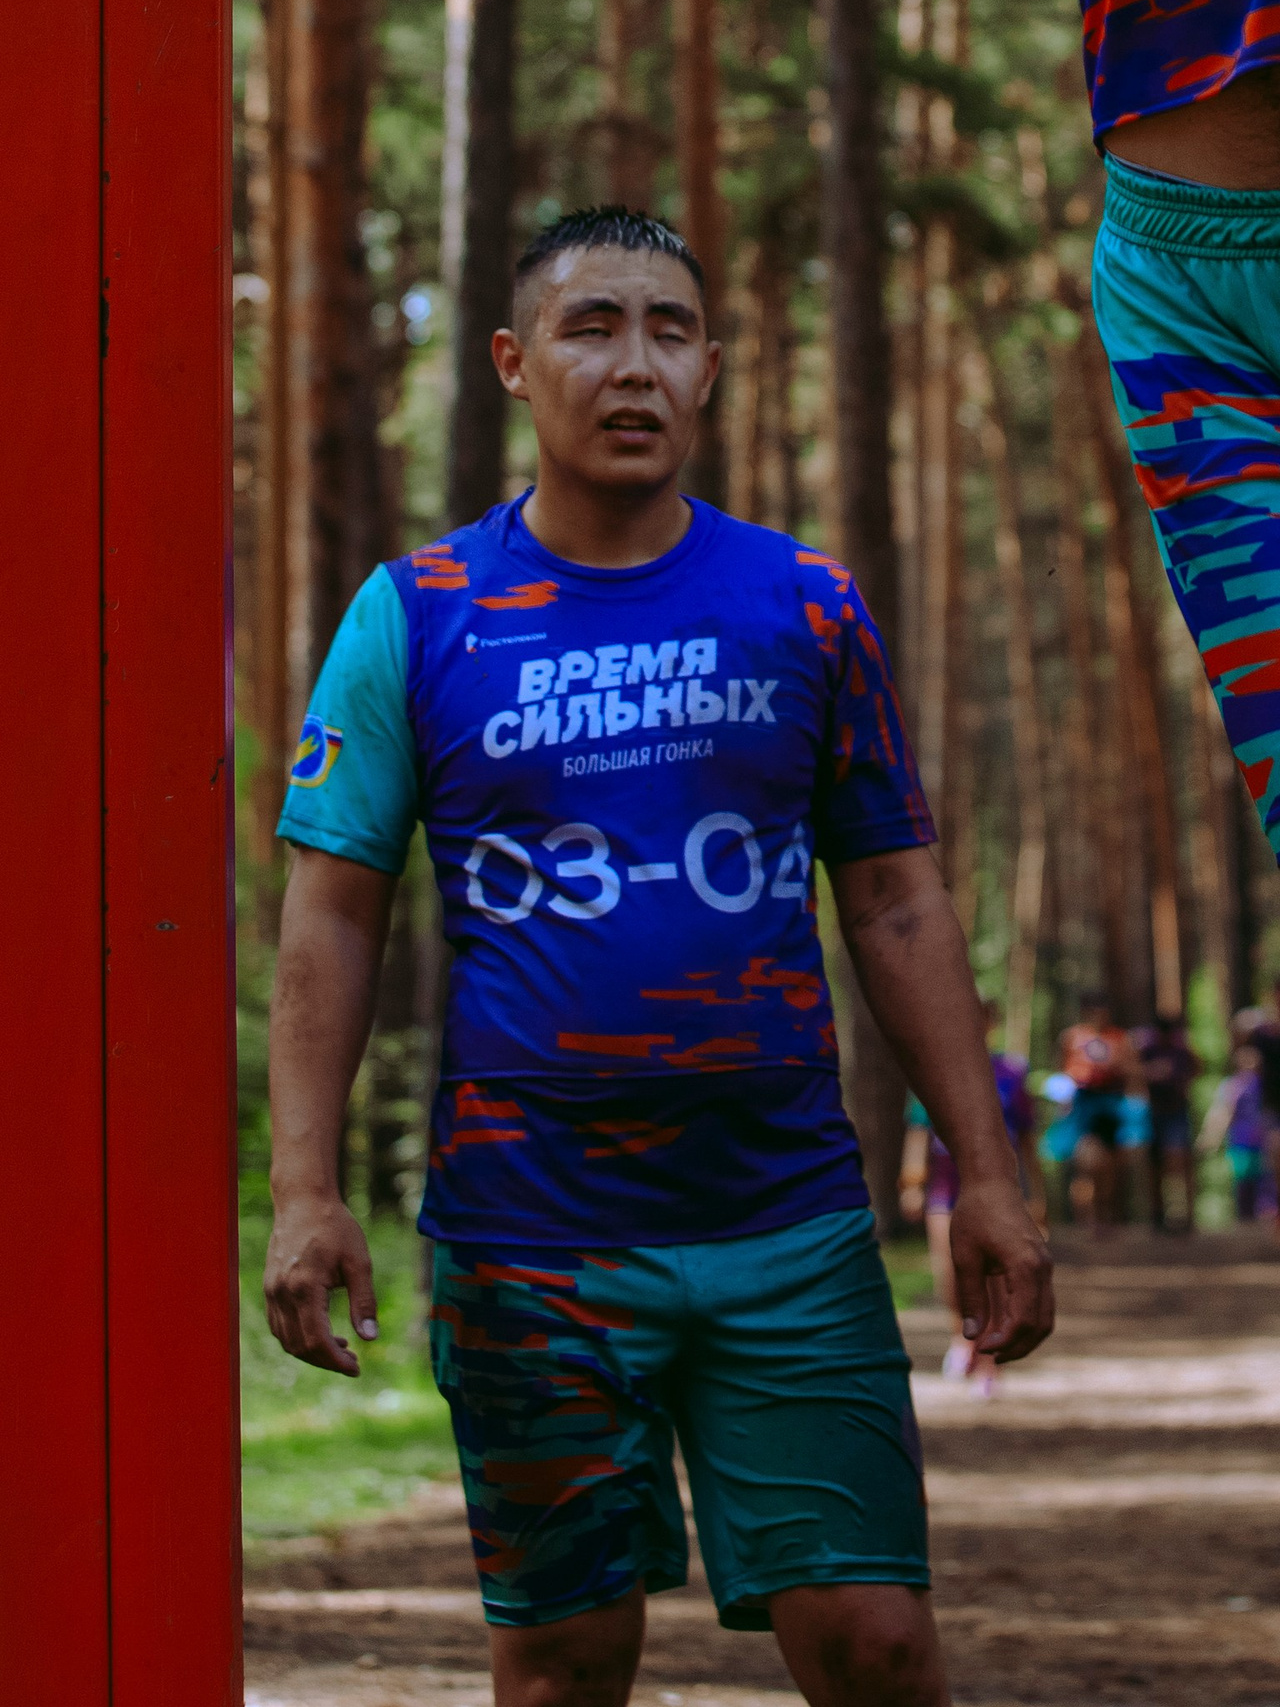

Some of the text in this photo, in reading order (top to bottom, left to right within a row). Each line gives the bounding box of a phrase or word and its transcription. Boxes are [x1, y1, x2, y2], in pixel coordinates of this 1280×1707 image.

[517, 637, 718, 704] ВРЕМЯ
[483, 679, 779, 759] СИЛЬНЫХ
[563, 738, 714, 777] БОЛЬШАЯ ГОНКА
[464, 812, 811, 924] 03-04
